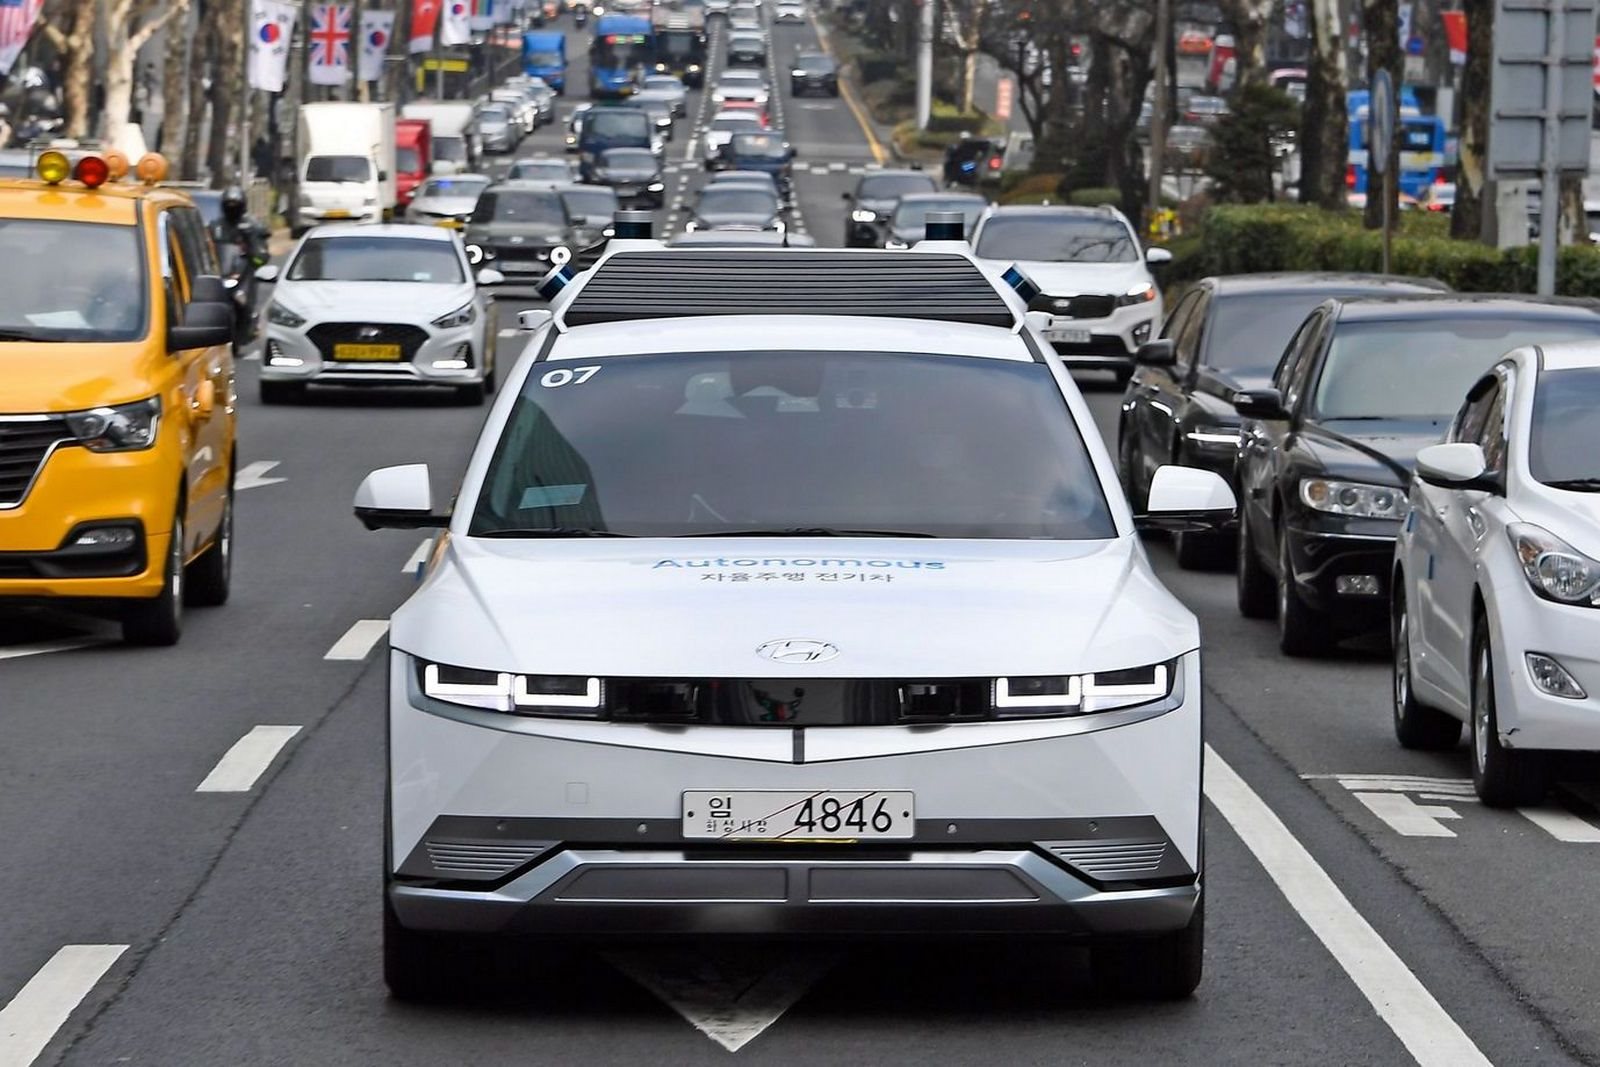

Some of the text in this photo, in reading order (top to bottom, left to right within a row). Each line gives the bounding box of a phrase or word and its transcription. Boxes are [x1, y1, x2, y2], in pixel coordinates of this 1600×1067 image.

[540, 365, 602, 388] 07
[652, 557, 946, 570] Autonomous
[701, 572, 895, 582] 자율주행 전기차
[708, 797, 731, 818] 임
[794, 796, 892, 833] 4846
